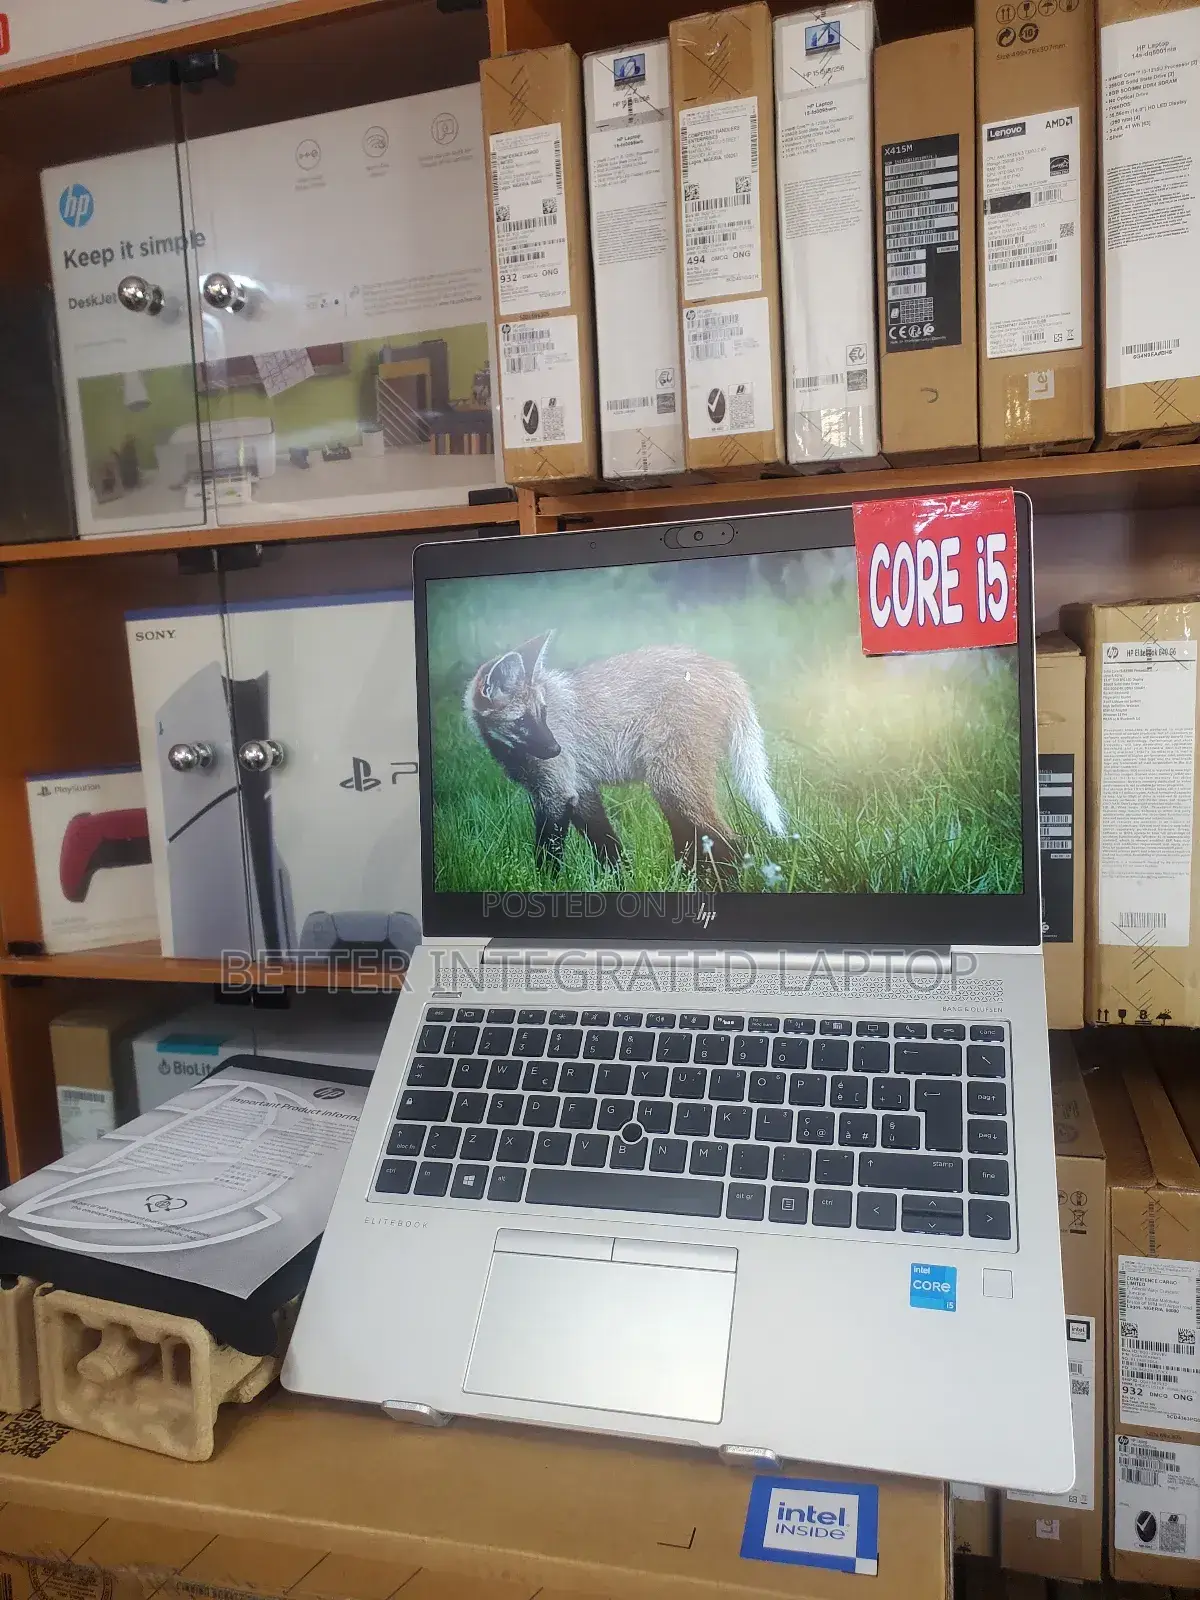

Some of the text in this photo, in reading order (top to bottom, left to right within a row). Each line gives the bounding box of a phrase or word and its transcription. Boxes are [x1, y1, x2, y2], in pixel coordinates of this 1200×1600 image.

[1045, 118, 1066, 130] AMD
[688, 130, 715, 139] COMPETENT
[989, 126, 1024, 138] Lenovo
[884, 144, 913, 156] X415M
[64, 230, 206, 269] Keep it simple
[686, 255, 705, 265] 494
[732, 250, 750, 258] ONG
[500, 274, 517, 283] 932
[542, 268, 559, 277] ONG
[869, 532, 1009, 628] CORE i5
[135, 629, 176, 642] SONY
[462, 1064, 470, 1072] Q
[531, 1067, 537, 1075] E
[604, 1070, 610, 1078] T
[798, 1080, 804, 1088] P
[230, 1098, 280, 1109] Important
[281, 1103, 322, 1116] Product
[461, 1099, 469, 1107] A
[496, 1101, 504, 1109] S
[568, 1104, 576, 1112] F
[607, 1106, 614, 1114] G
[644, 1107, 653, 1116] H
[684, 1110, 690, 1118] J
[724, 1113, 731, 1121] K
[764, 1115, 770, 1124] L
[469, 1135, 708, 1157] Z X C V B N M
[364, 1216, 429, 1228] ELITEBOOK
[913, 1265, 931, 1275] intel
[946, 1301, 954, 1309] i5
[1122, 1386, 1143, 1396] 932
[1173, 1394, 1193, 1402] ONG
[778, 1502, 846, 1526] intel
